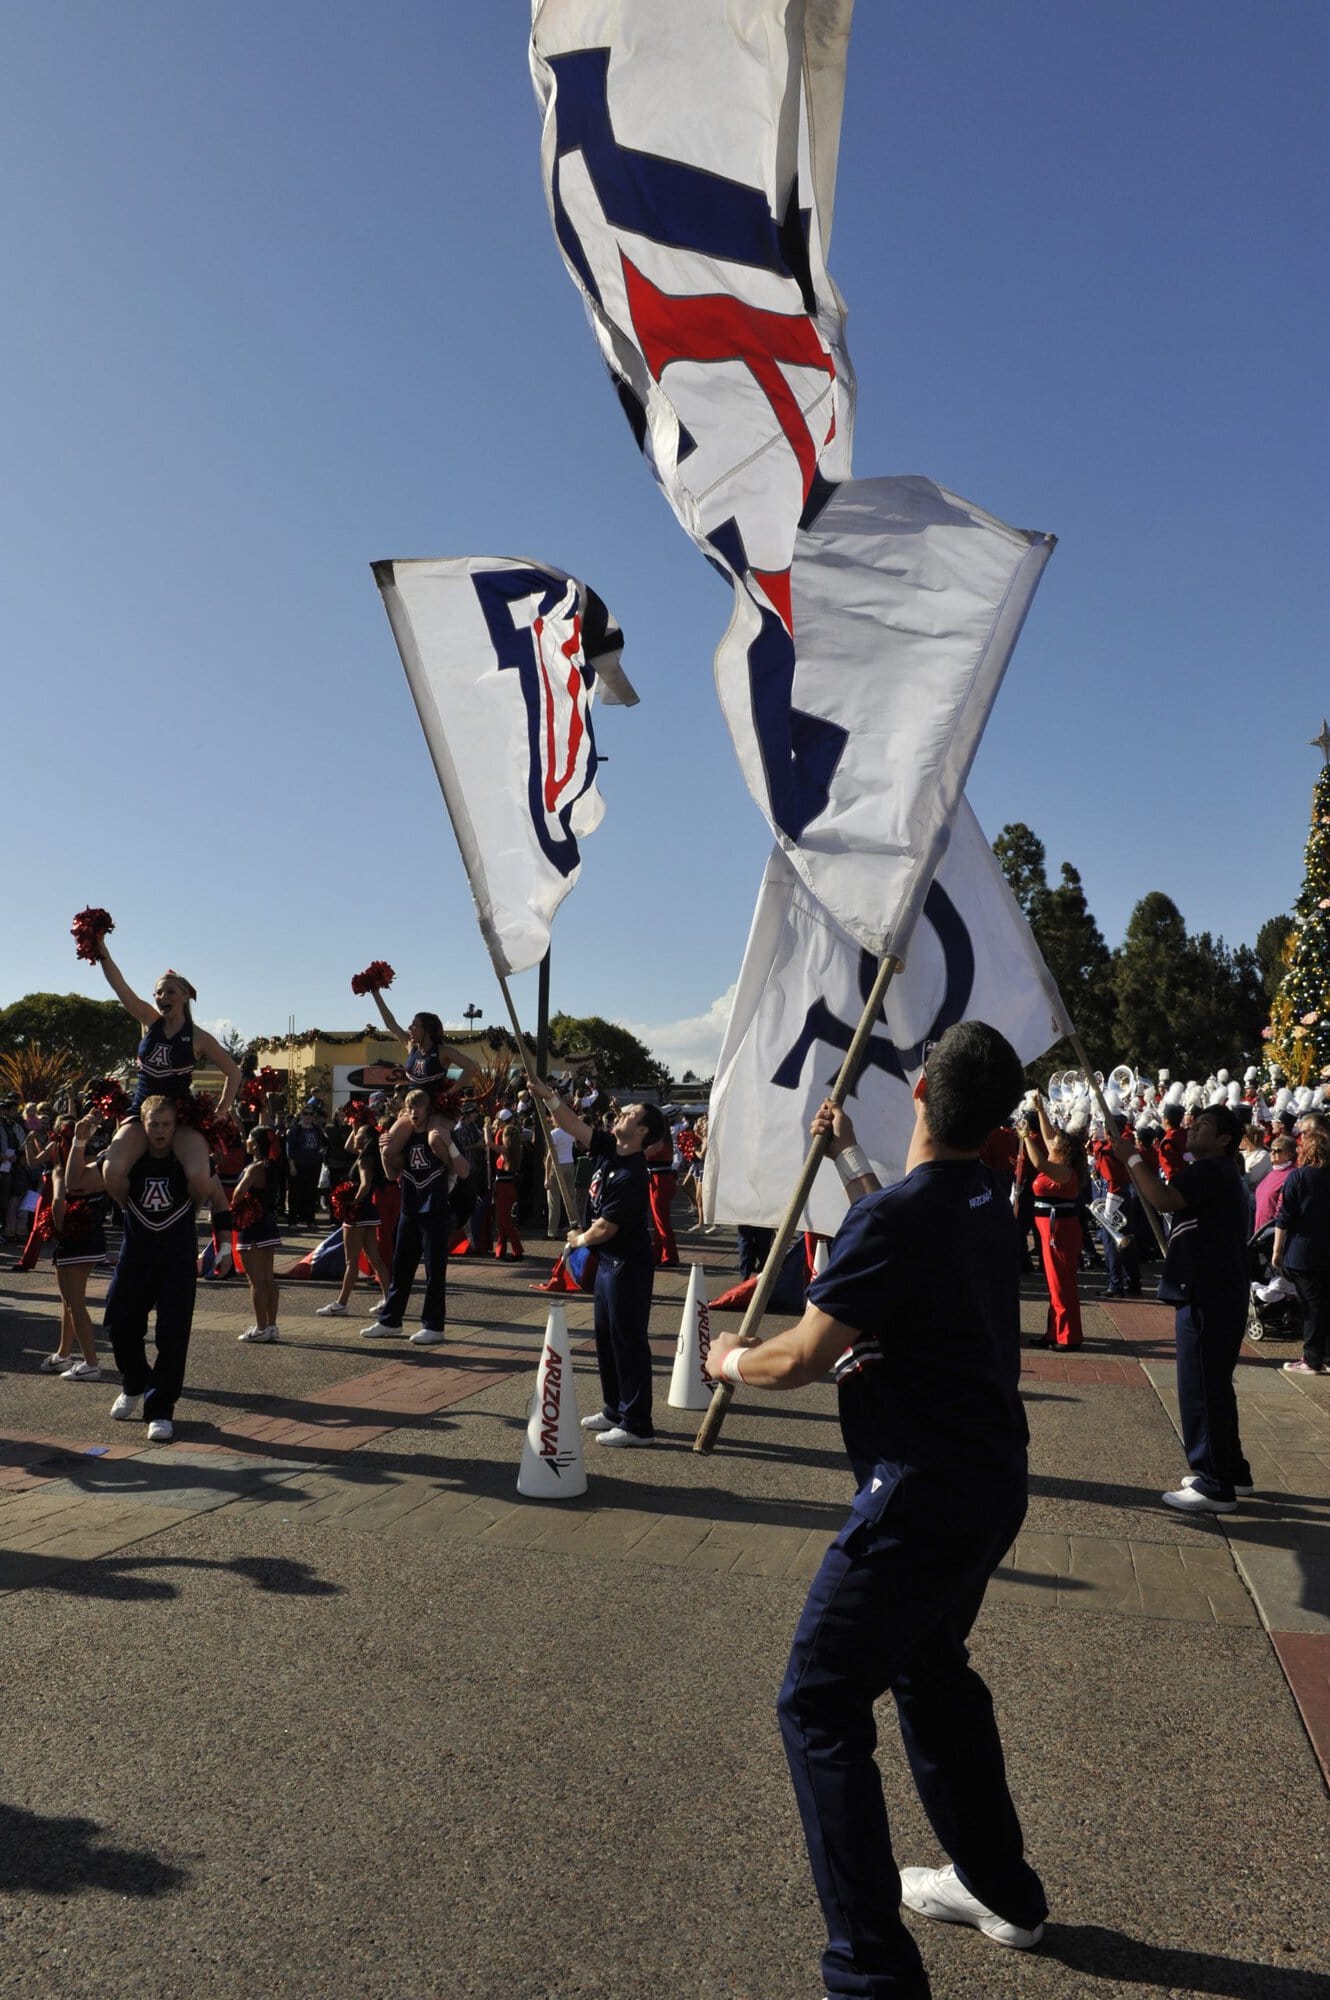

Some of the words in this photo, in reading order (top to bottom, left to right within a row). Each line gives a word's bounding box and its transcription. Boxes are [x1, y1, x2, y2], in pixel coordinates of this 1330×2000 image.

[147, 1044, 171, 1068] A
[410, 1145, 430, 1169] A
[141, 1178, 172, 1212] A
[540, 1344, 562, 1456] ARIZONA
